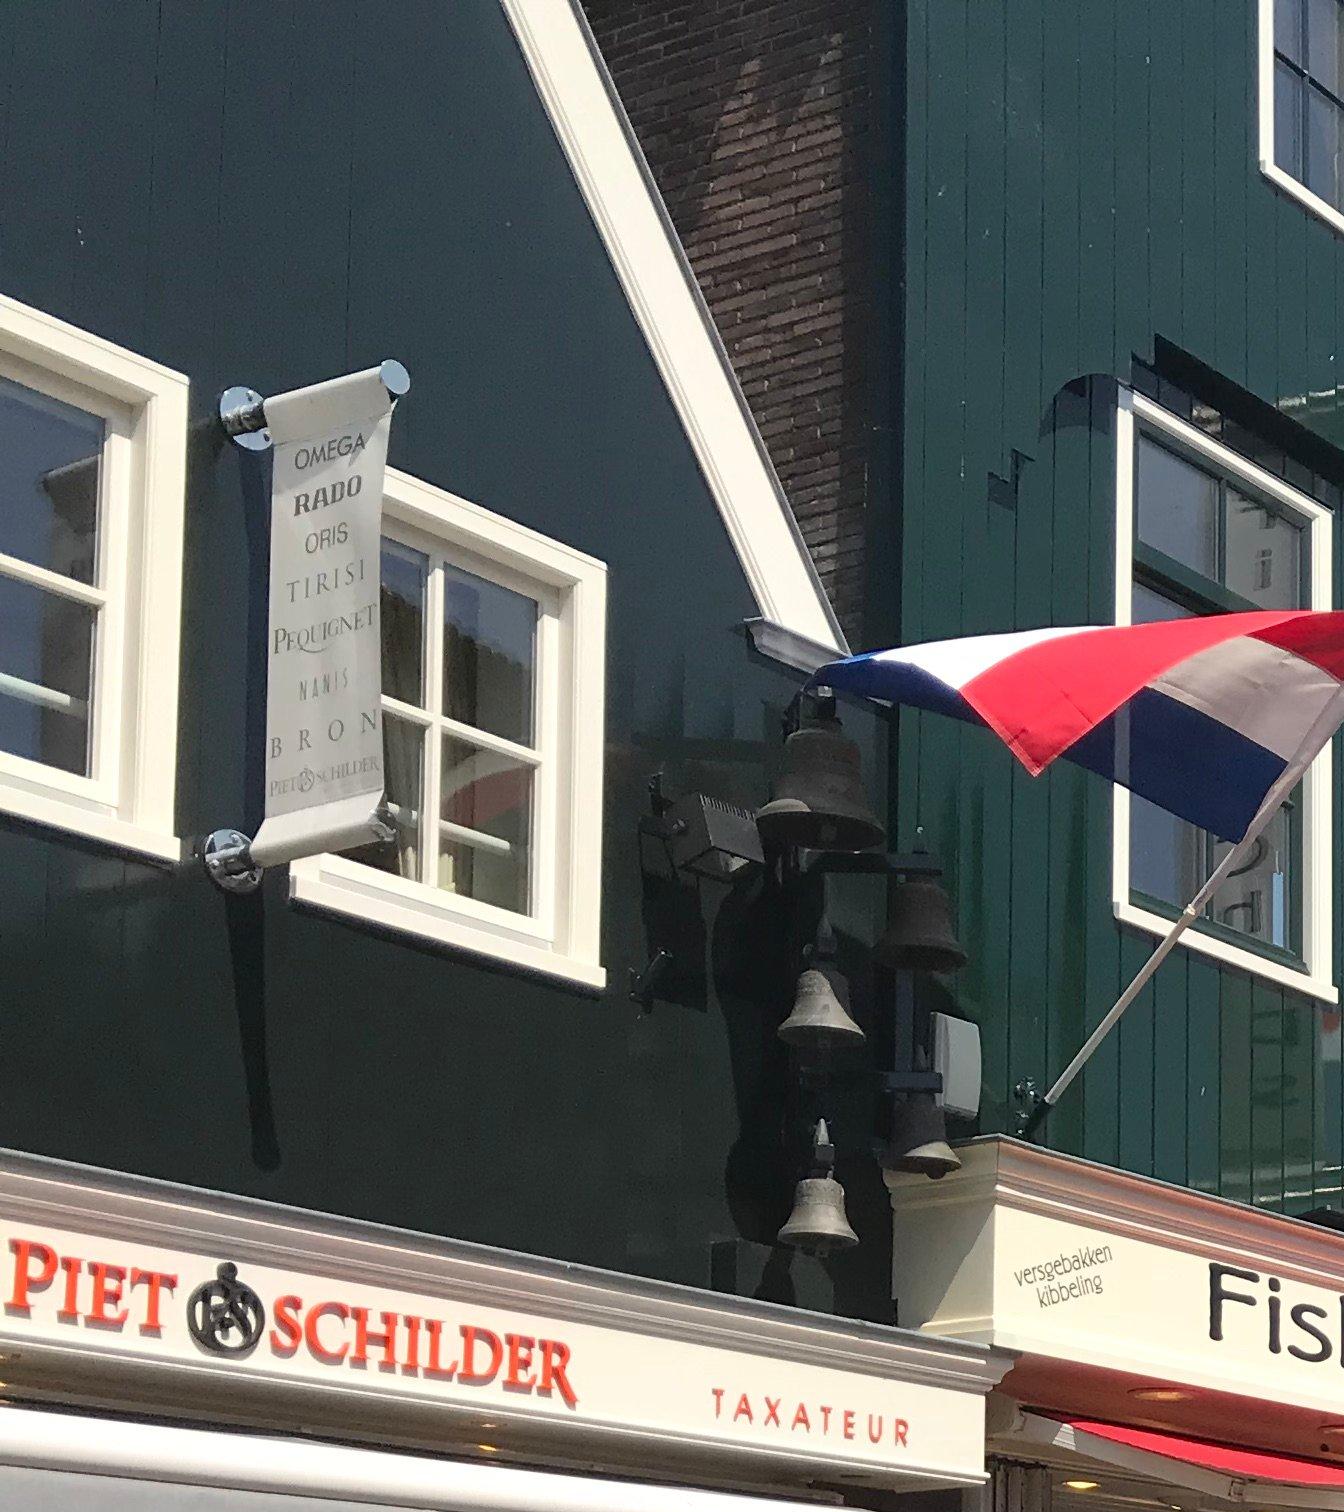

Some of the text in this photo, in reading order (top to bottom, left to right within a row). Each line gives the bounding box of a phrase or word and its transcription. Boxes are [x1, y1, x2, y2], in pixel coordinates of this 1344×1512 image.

[295, 433, 366, 470] OMEGA
[293, 474, 361, 516] RADO
[305, 521, 348, 554] ORIS
[287, 558, 364, 602] TIRISI
[300, 668, 348, 701] NANIS
[1014, 1244, 1113, 1288] versgebakken
[1036, 1271, 1104, 1310] kibbeling
[5, 1237, 177, 1336] PIET
[270, 1295, 578, 1407] SCHILDER
[711, 1387, 911, 1449] TAXATEUR
